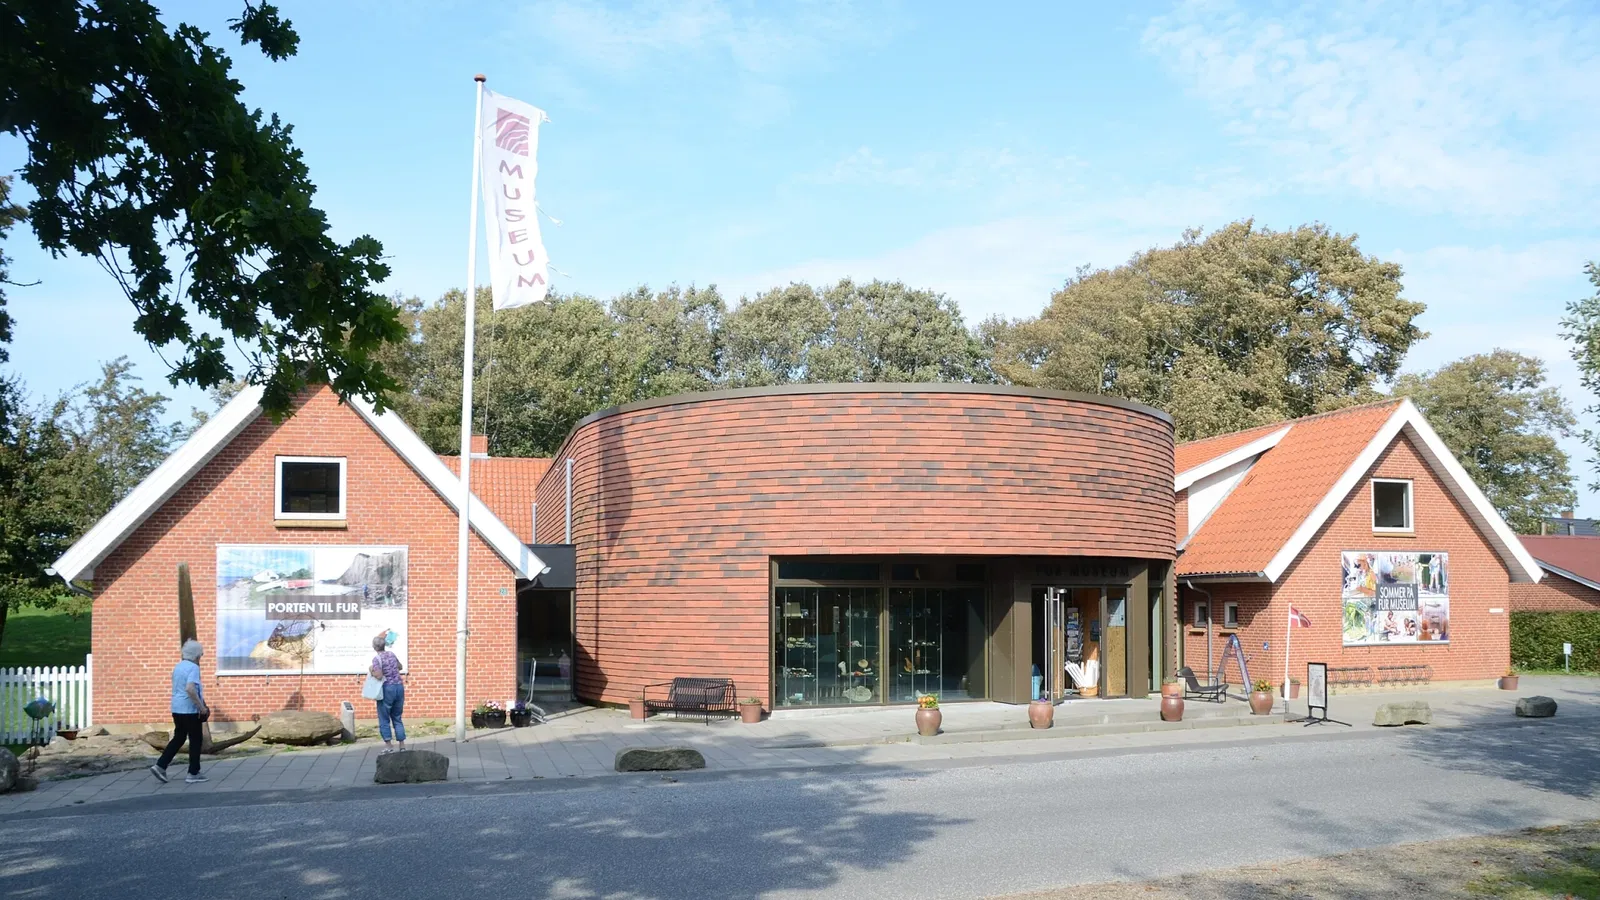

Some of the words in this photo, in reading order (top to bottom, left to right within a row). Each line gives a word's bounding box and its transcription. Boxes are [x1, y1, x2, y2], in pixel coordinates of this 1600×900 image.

[499, 159, 545, 288] MUSEUM
[1070, 564, 1129, 577] MUSEUM
[1380, 586, 1406, 598] SOMMER
[1407, 583, 1414, 598] PÅ
[268, 602, 315, 613] PORTEN
[318, 602, 333, 613] TIL
[336, 602, 358, 613] FUR
[1378, 598, 1389, 610] FUR
[1390, 598, 1415, 610] MUSEUM
